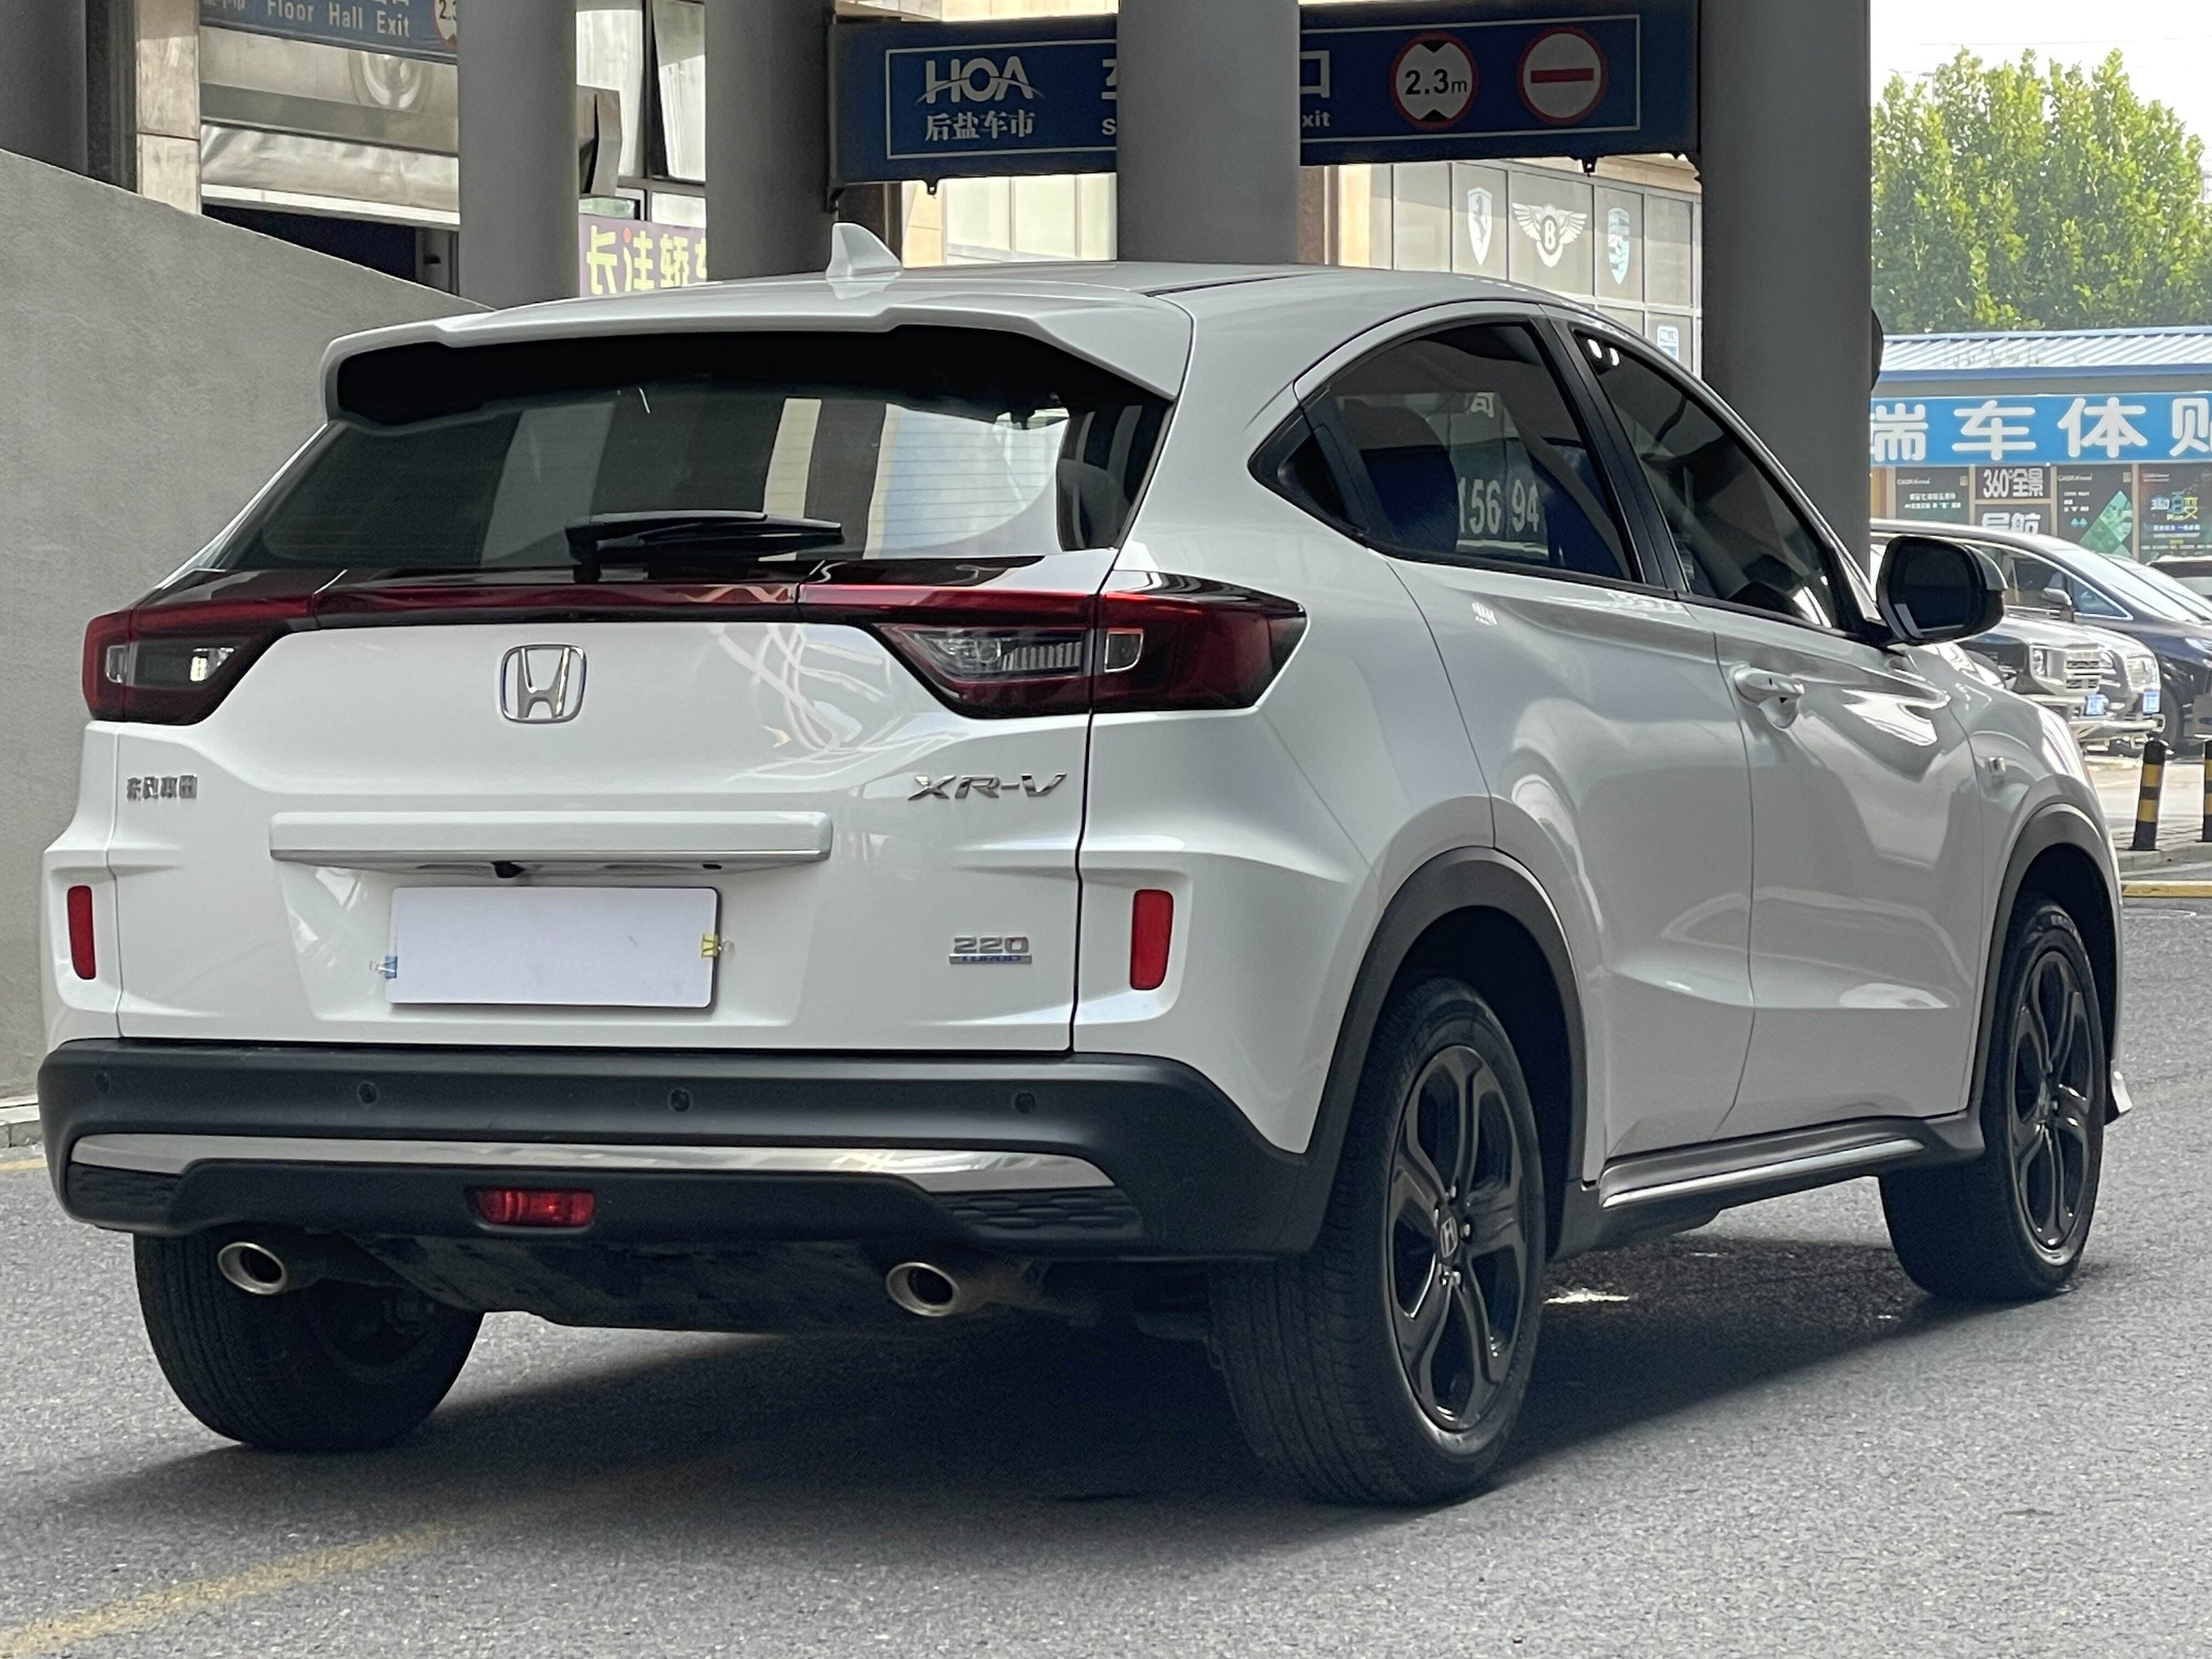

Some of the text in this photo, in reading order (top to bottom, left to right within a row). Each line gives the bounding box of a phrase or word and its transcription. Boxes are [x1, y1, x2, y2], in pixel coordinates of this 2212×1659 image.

[267, 0, 314, 22] Floor
[329, 3, 363, 30] Hall
[376, 9, 410, 37] Exit
[925, 55, 1034, 104] HOA
[1405, 69, 1468, 95] 2.3m
[925, 110, 1036, 141] 后盐车市
[1102, 111, 1330, 135] S xit
[907, 773, 1067, 801] XR-V
[953, 936, 1029, 953] 220
